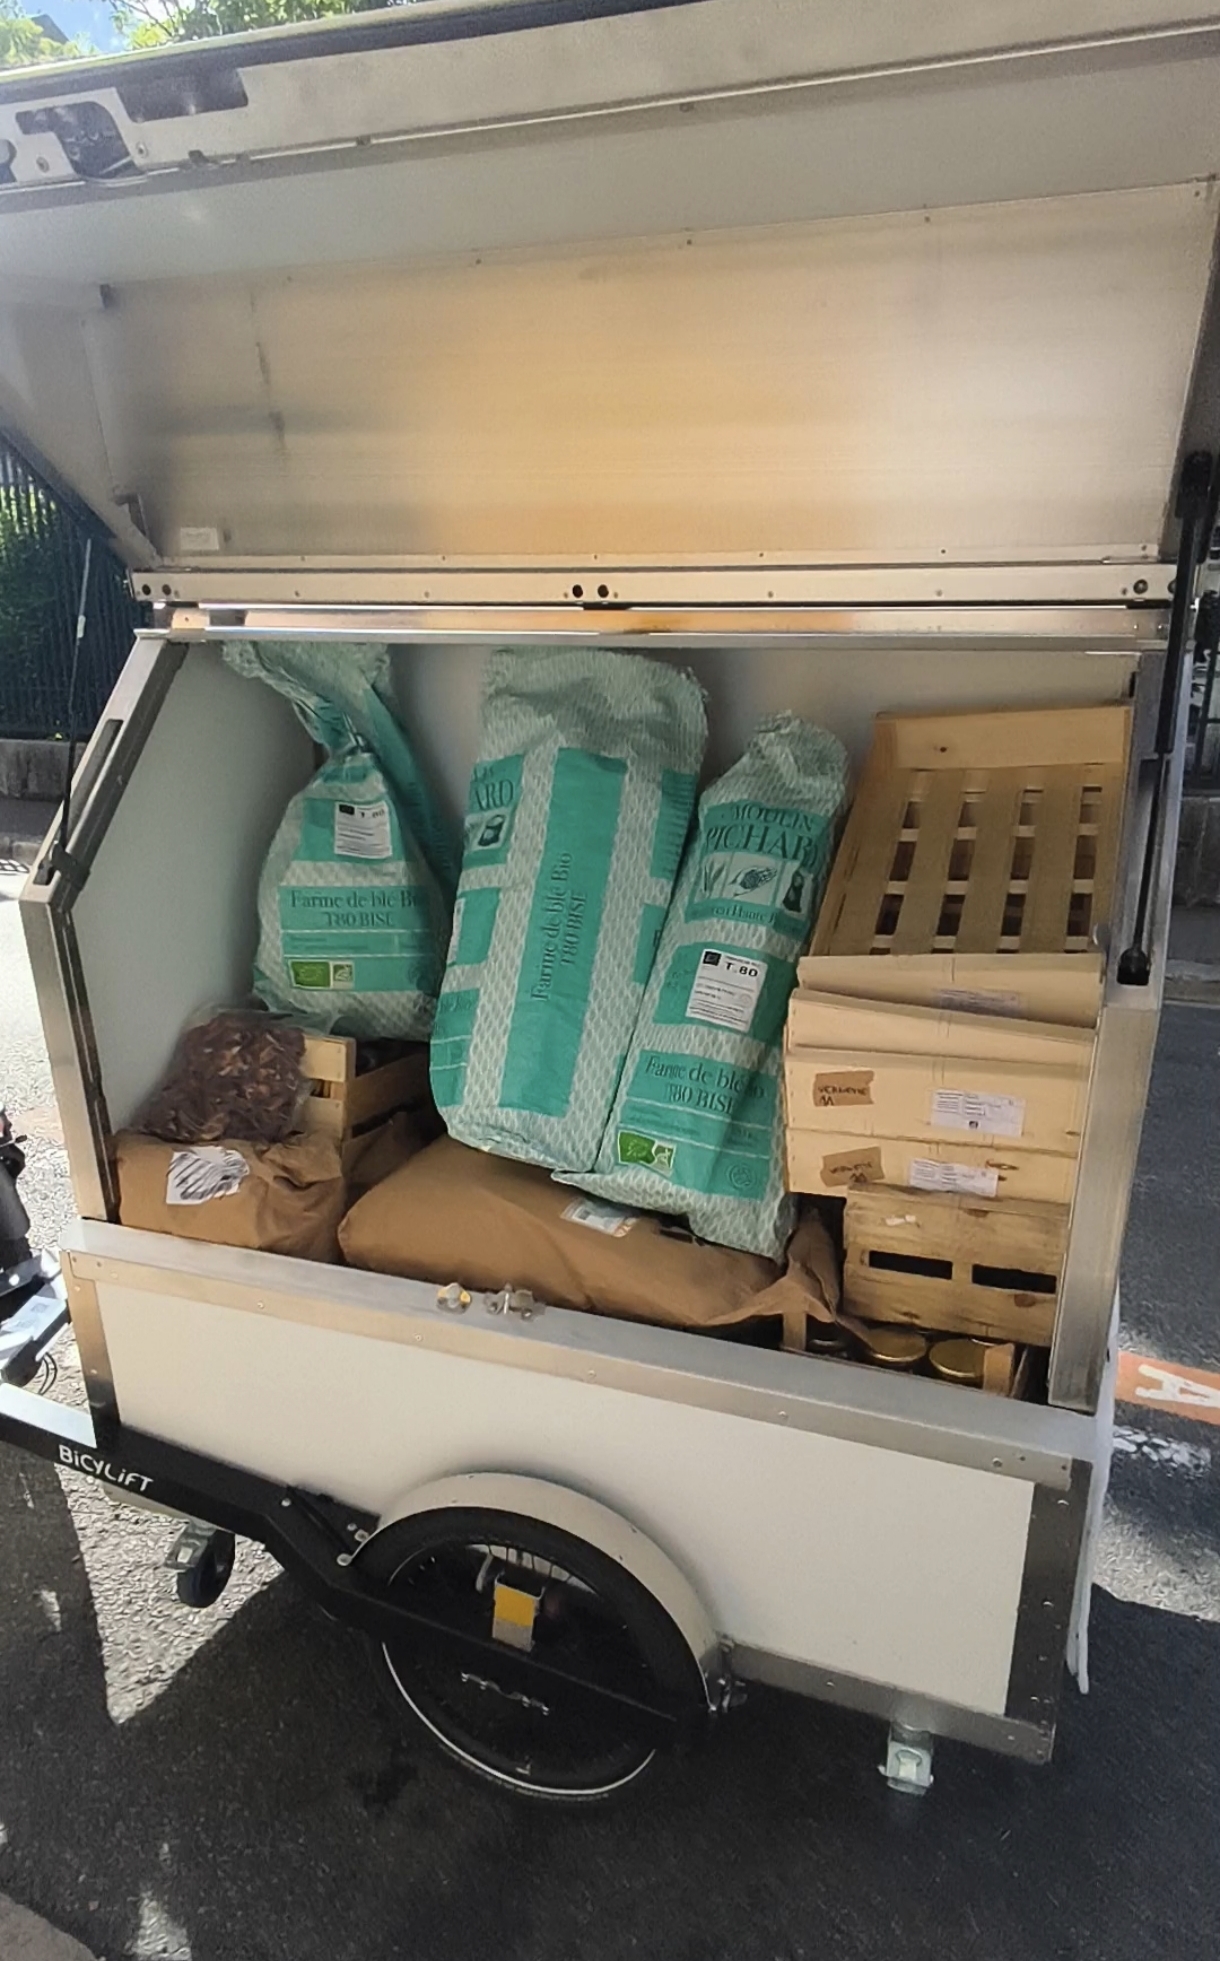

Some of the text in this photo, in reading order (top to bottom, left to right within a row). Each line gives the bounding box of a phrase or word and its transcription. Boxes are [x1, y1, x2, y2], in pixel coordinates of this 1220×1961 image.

[731, 803, 812, 832] MOULIN
[550, 852, 573, 881] Bio
[347, 889, 368, 908] de
[540, 918, 562, 939] de
[688, 1062, 713, 1085] de
